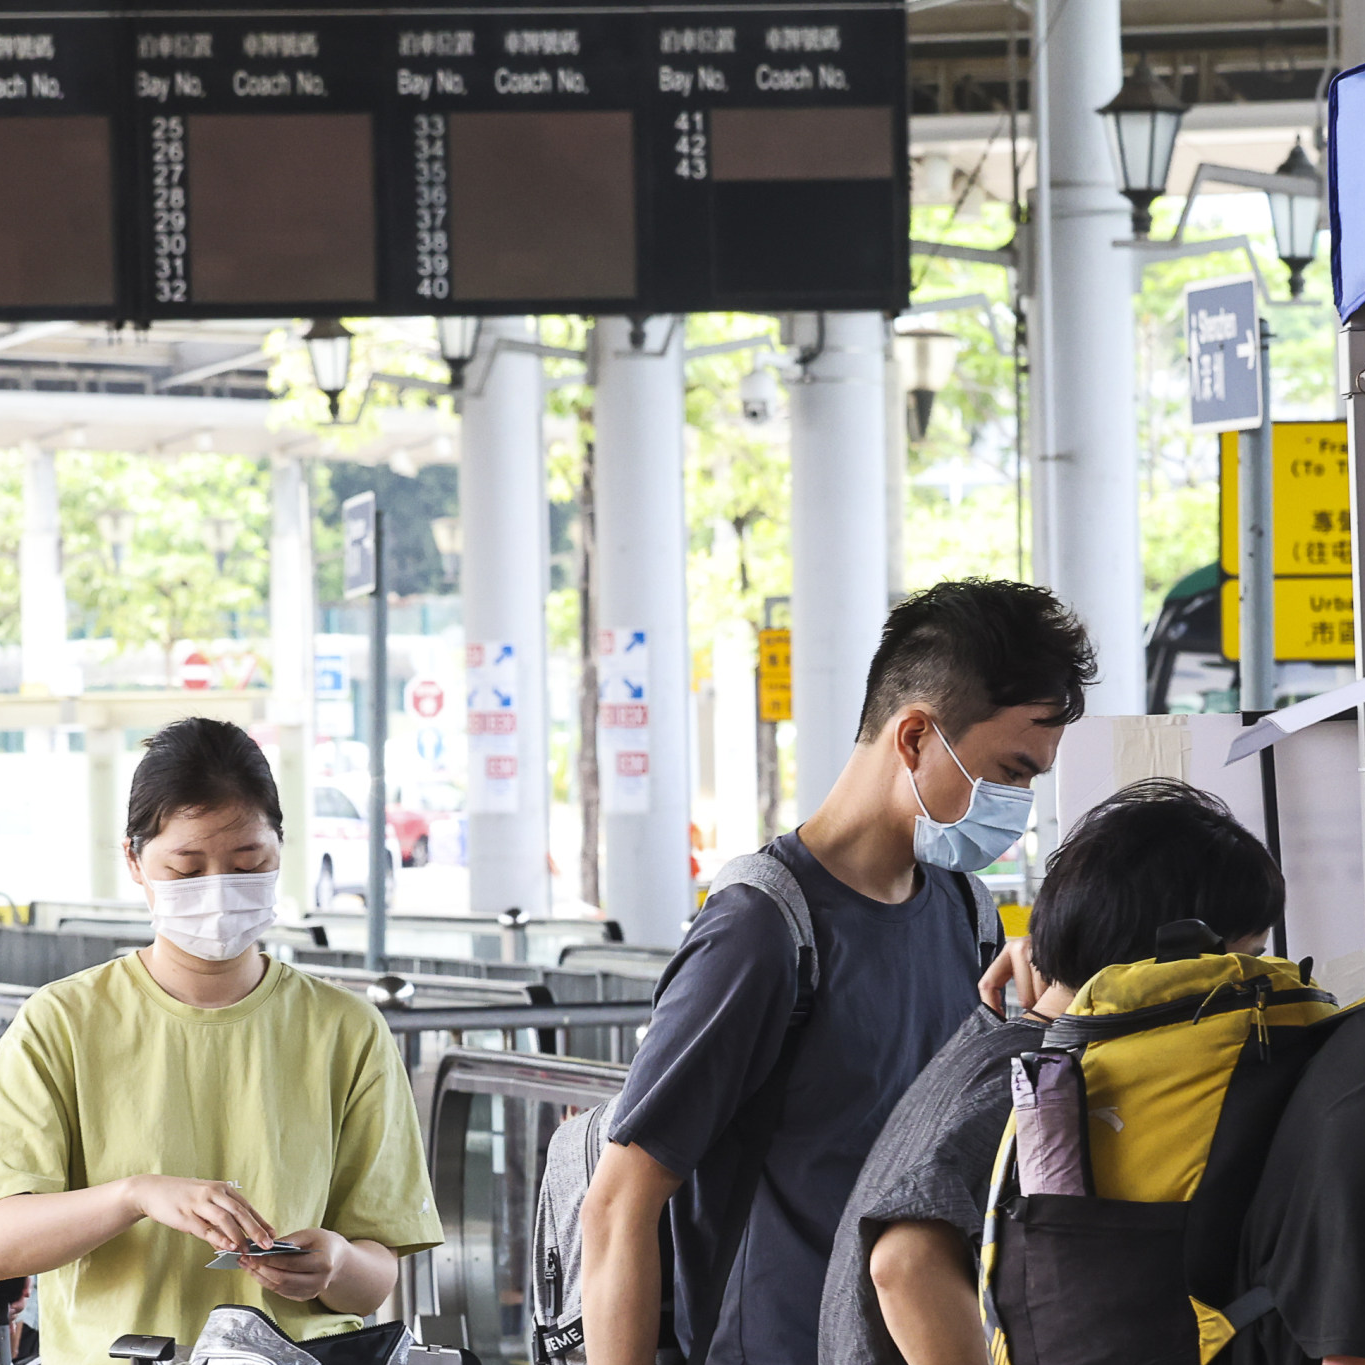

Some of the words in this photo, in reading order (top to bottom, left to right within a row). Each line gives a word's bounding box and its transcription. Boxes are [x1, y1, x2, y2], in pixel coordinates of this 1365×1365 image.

[32, 72, 65, 101] No.
[137, 71, 172, 102] Bay
[175, 71, 206, 98] No.
[233, 71, 291, 97] Coach
[296, 71, 327, 98] No.
[397, 68, 432, 100] Bay
[436, 68, 467, 96] No.
[494, 68, 552, 95] Coach
[557, 68, 589, 96] No.
[659, 65, 694, 97] Bay
[697, 65, 728, 93] No.
[756, 65, 813, 92] Coach
[818, 65, 850, 93] No.
[152, 116, 185, 139] 25
[415, 114, 446, 137] 33
[673, 112, 704, 134] 41
[152, 139, 185, 162] 26
[415, 137, 445, 160] 34
[674, 134, 707, 157] 42
[153, 162, 185, 186] 27
[416, 160, 447, 183] 35
[674, 157, 708, 179] 43
[153, 186, 186, 209] 28
[416, 183, 448, 206] 36
[154, 209, 187, 232] 29
[416, 206, 448, 230] 37
[155, 232, 187, 256] 30
[416, 230, 449, 253] 38
[155, 256, 185, 279] 31
[416, 253, 450, 276] 39
[156, 279, 188, 302] 32
[416, 276, 450, 299] 40
[1309, 596, 1354, 613] Urba
[543, 1327, 583, 1353] EME
